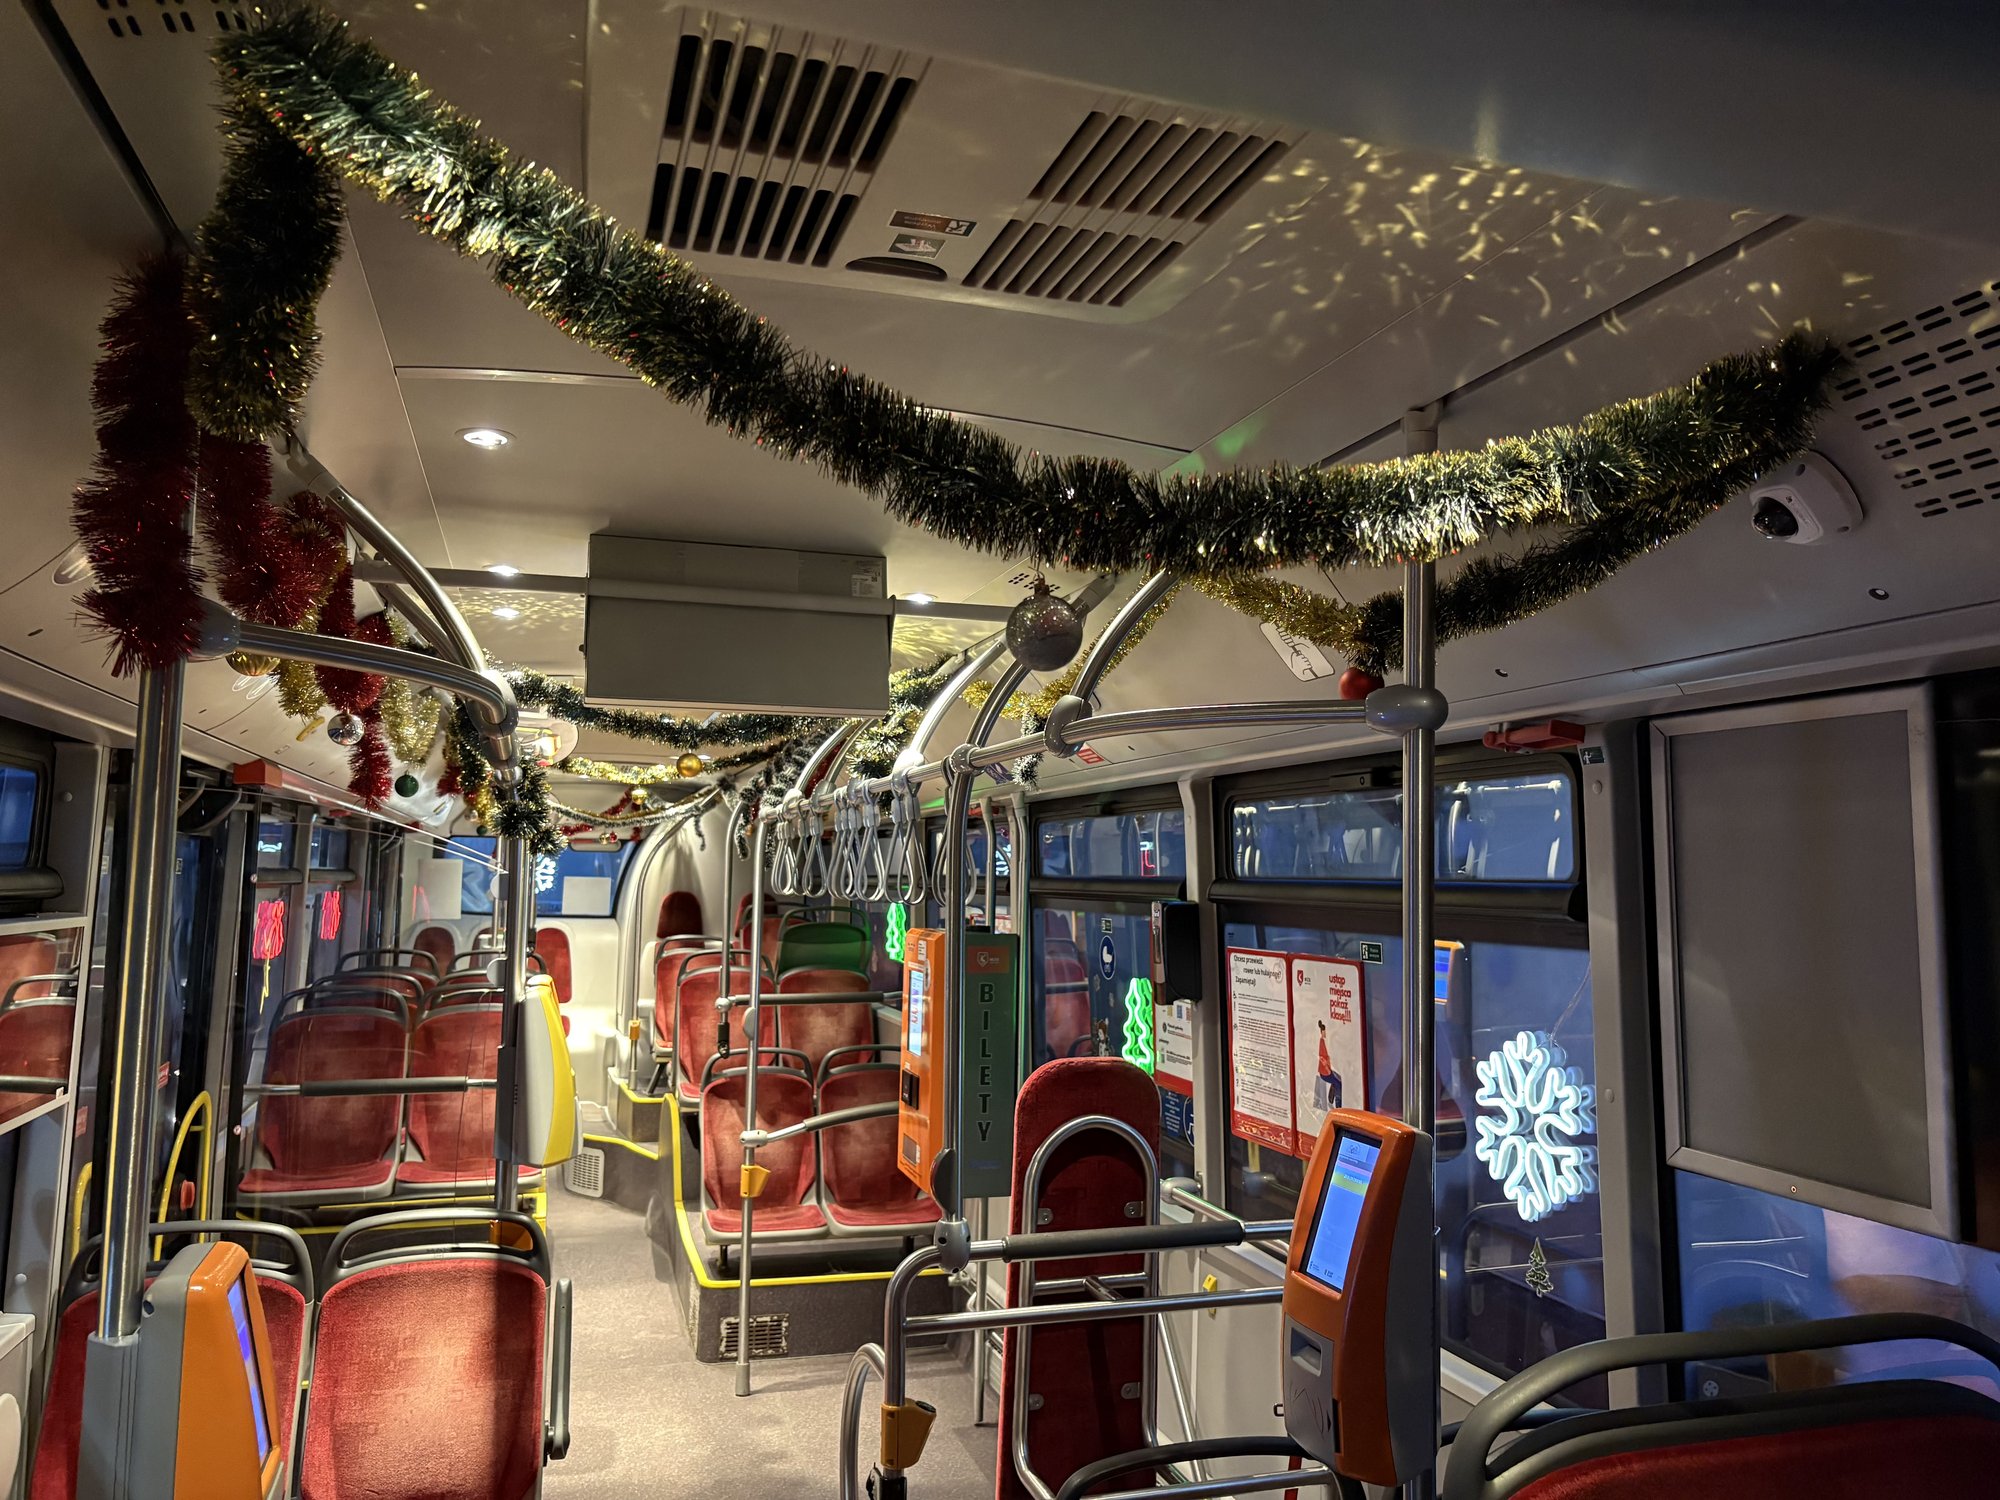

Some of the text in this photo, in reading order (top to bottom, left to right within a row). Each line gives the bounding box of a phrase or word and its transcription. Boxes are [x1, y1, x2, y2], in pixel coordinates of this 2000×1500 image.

[1329, 973, 1346, 988] ustąp
[1330, 984, 1352, 1000] miejsca
[1330, 997, 1349, 1012] pokaż
[977, 983, 995, 1142] BILETY
